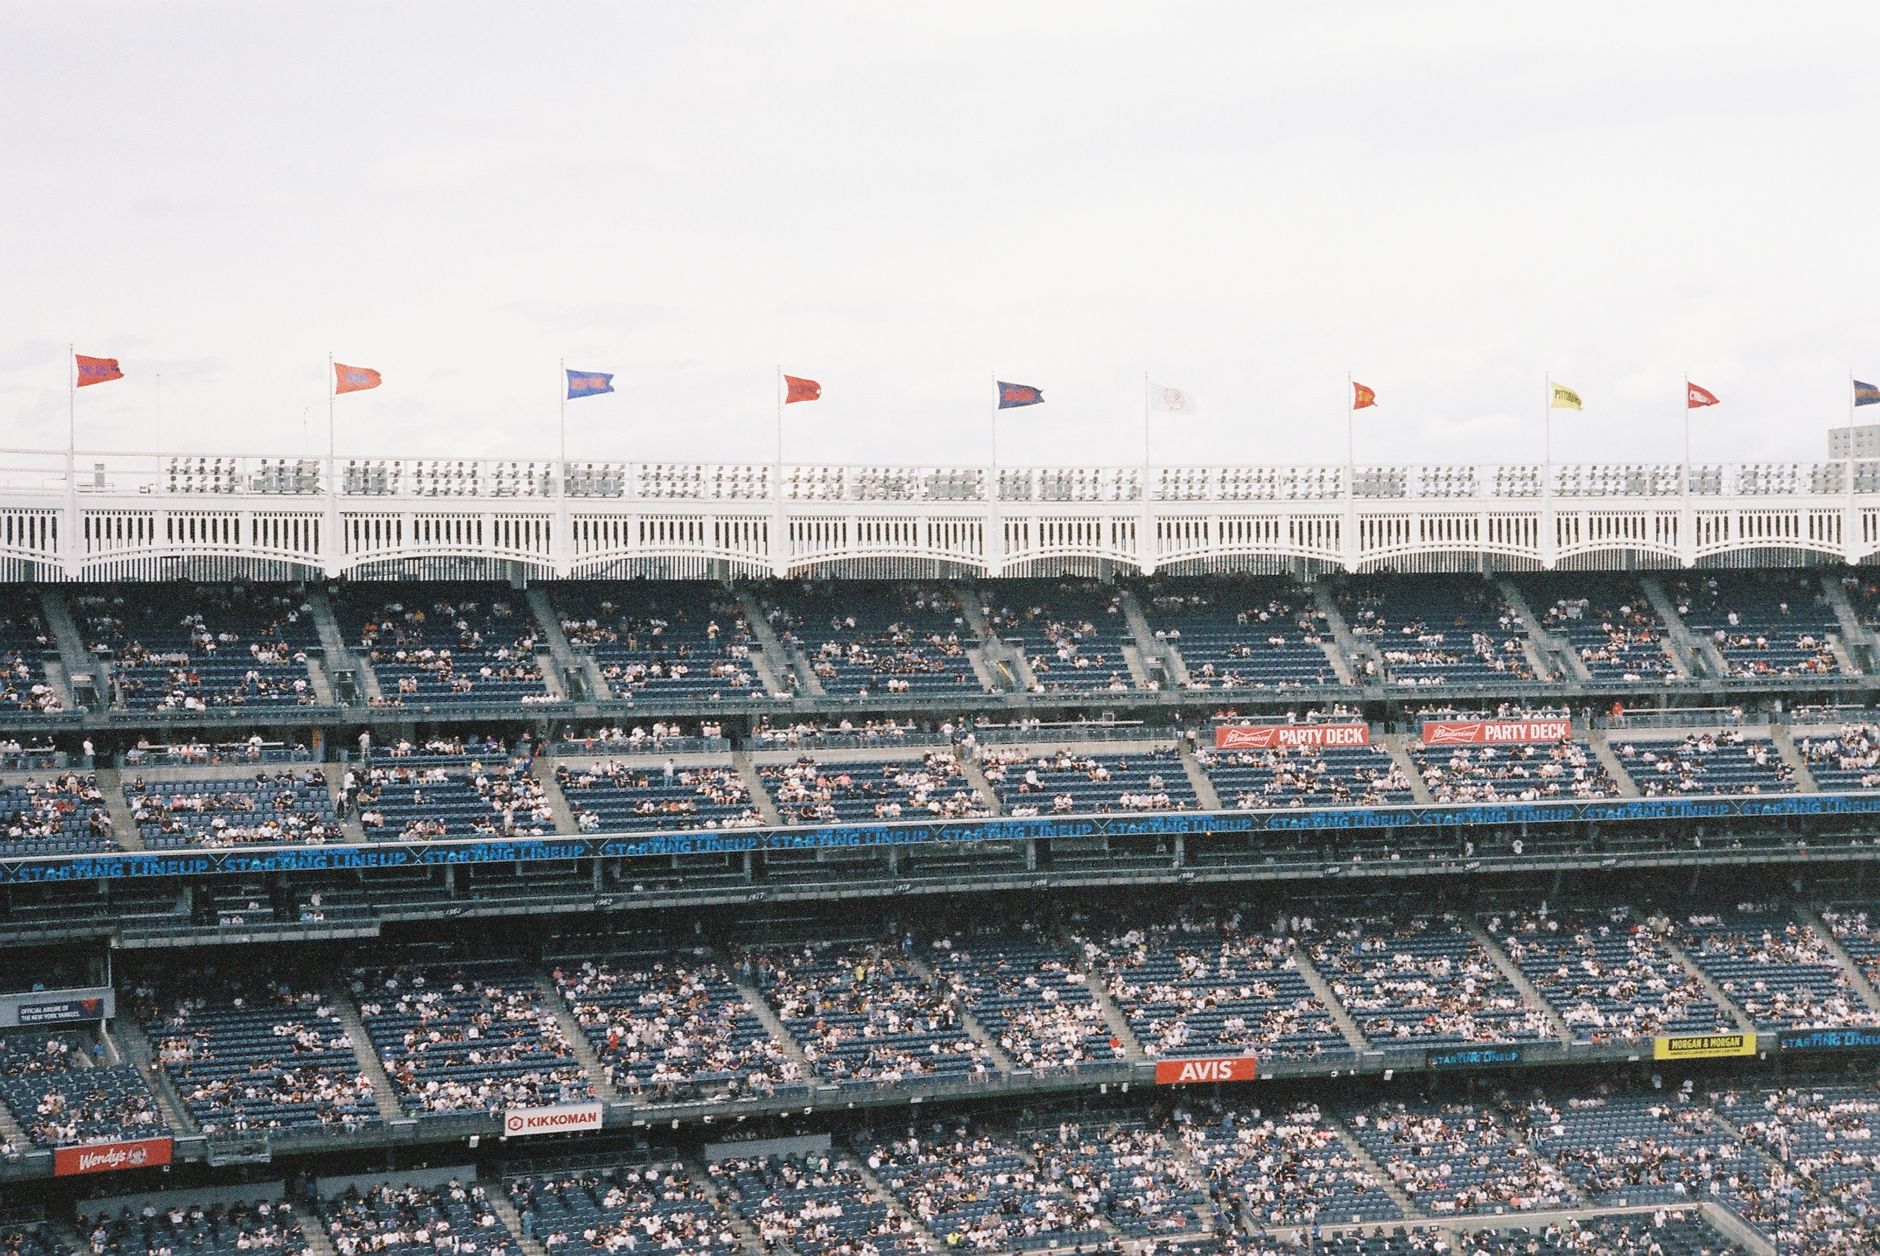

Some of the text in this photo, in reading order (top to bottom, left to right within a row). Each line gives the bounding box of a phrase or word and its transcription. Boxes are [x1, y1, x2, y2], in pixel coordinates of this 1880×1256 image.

[1555, 389, 1582, 407] PITTSBU
[1228, 728, 1364, 744] Budweiser PARTY DECK
[1436, 723, 1566, 740] Budweiser PARTY DECK
[1423, 810, 1507, 825] STARTING
[1513, 808, 1573, 822] LINEUP
[1586, 805, 1667, 820] STARTING
[1673, 804, 1729, 818] LINEUP
[1108, 820, 1189, 834] STARTING
[1194, 818, 1250, 832] LINEUP
[1270, 815, 1349, 830] STARTING
[1354, 814, 1412, 827] LINEUP
[770, 834, 860, 849] STARTING
[865, 830, 929, 845] LINEUP
[943, 826, 1025, 841] STARTING
[1031, 823, 1093, 838] LINEUP
[424, 848, 515, 864] STARTING
[521, 845, 585, 860] LINEUP
[605, 840, 691, 856] STARTING
[696, 837, 757, 852] LINEUP
[18, 864, 123, 881] STARTING
[131, 859, 208, 877] LINEUP
[225, 856, 328, 872] STARTING
[333, 852, 407, 868] LINEUP
[21, 1007, 41, 1015] OFFICIAL
[1671, 1036, 1740, 1049] MORGAN & MORGAN
[1179, 1060, 1233, 1081] AVIS
[527, 1112, 597, 1128] KIKKOMAN
[79, 1148, 127, 1170] Wendy's
